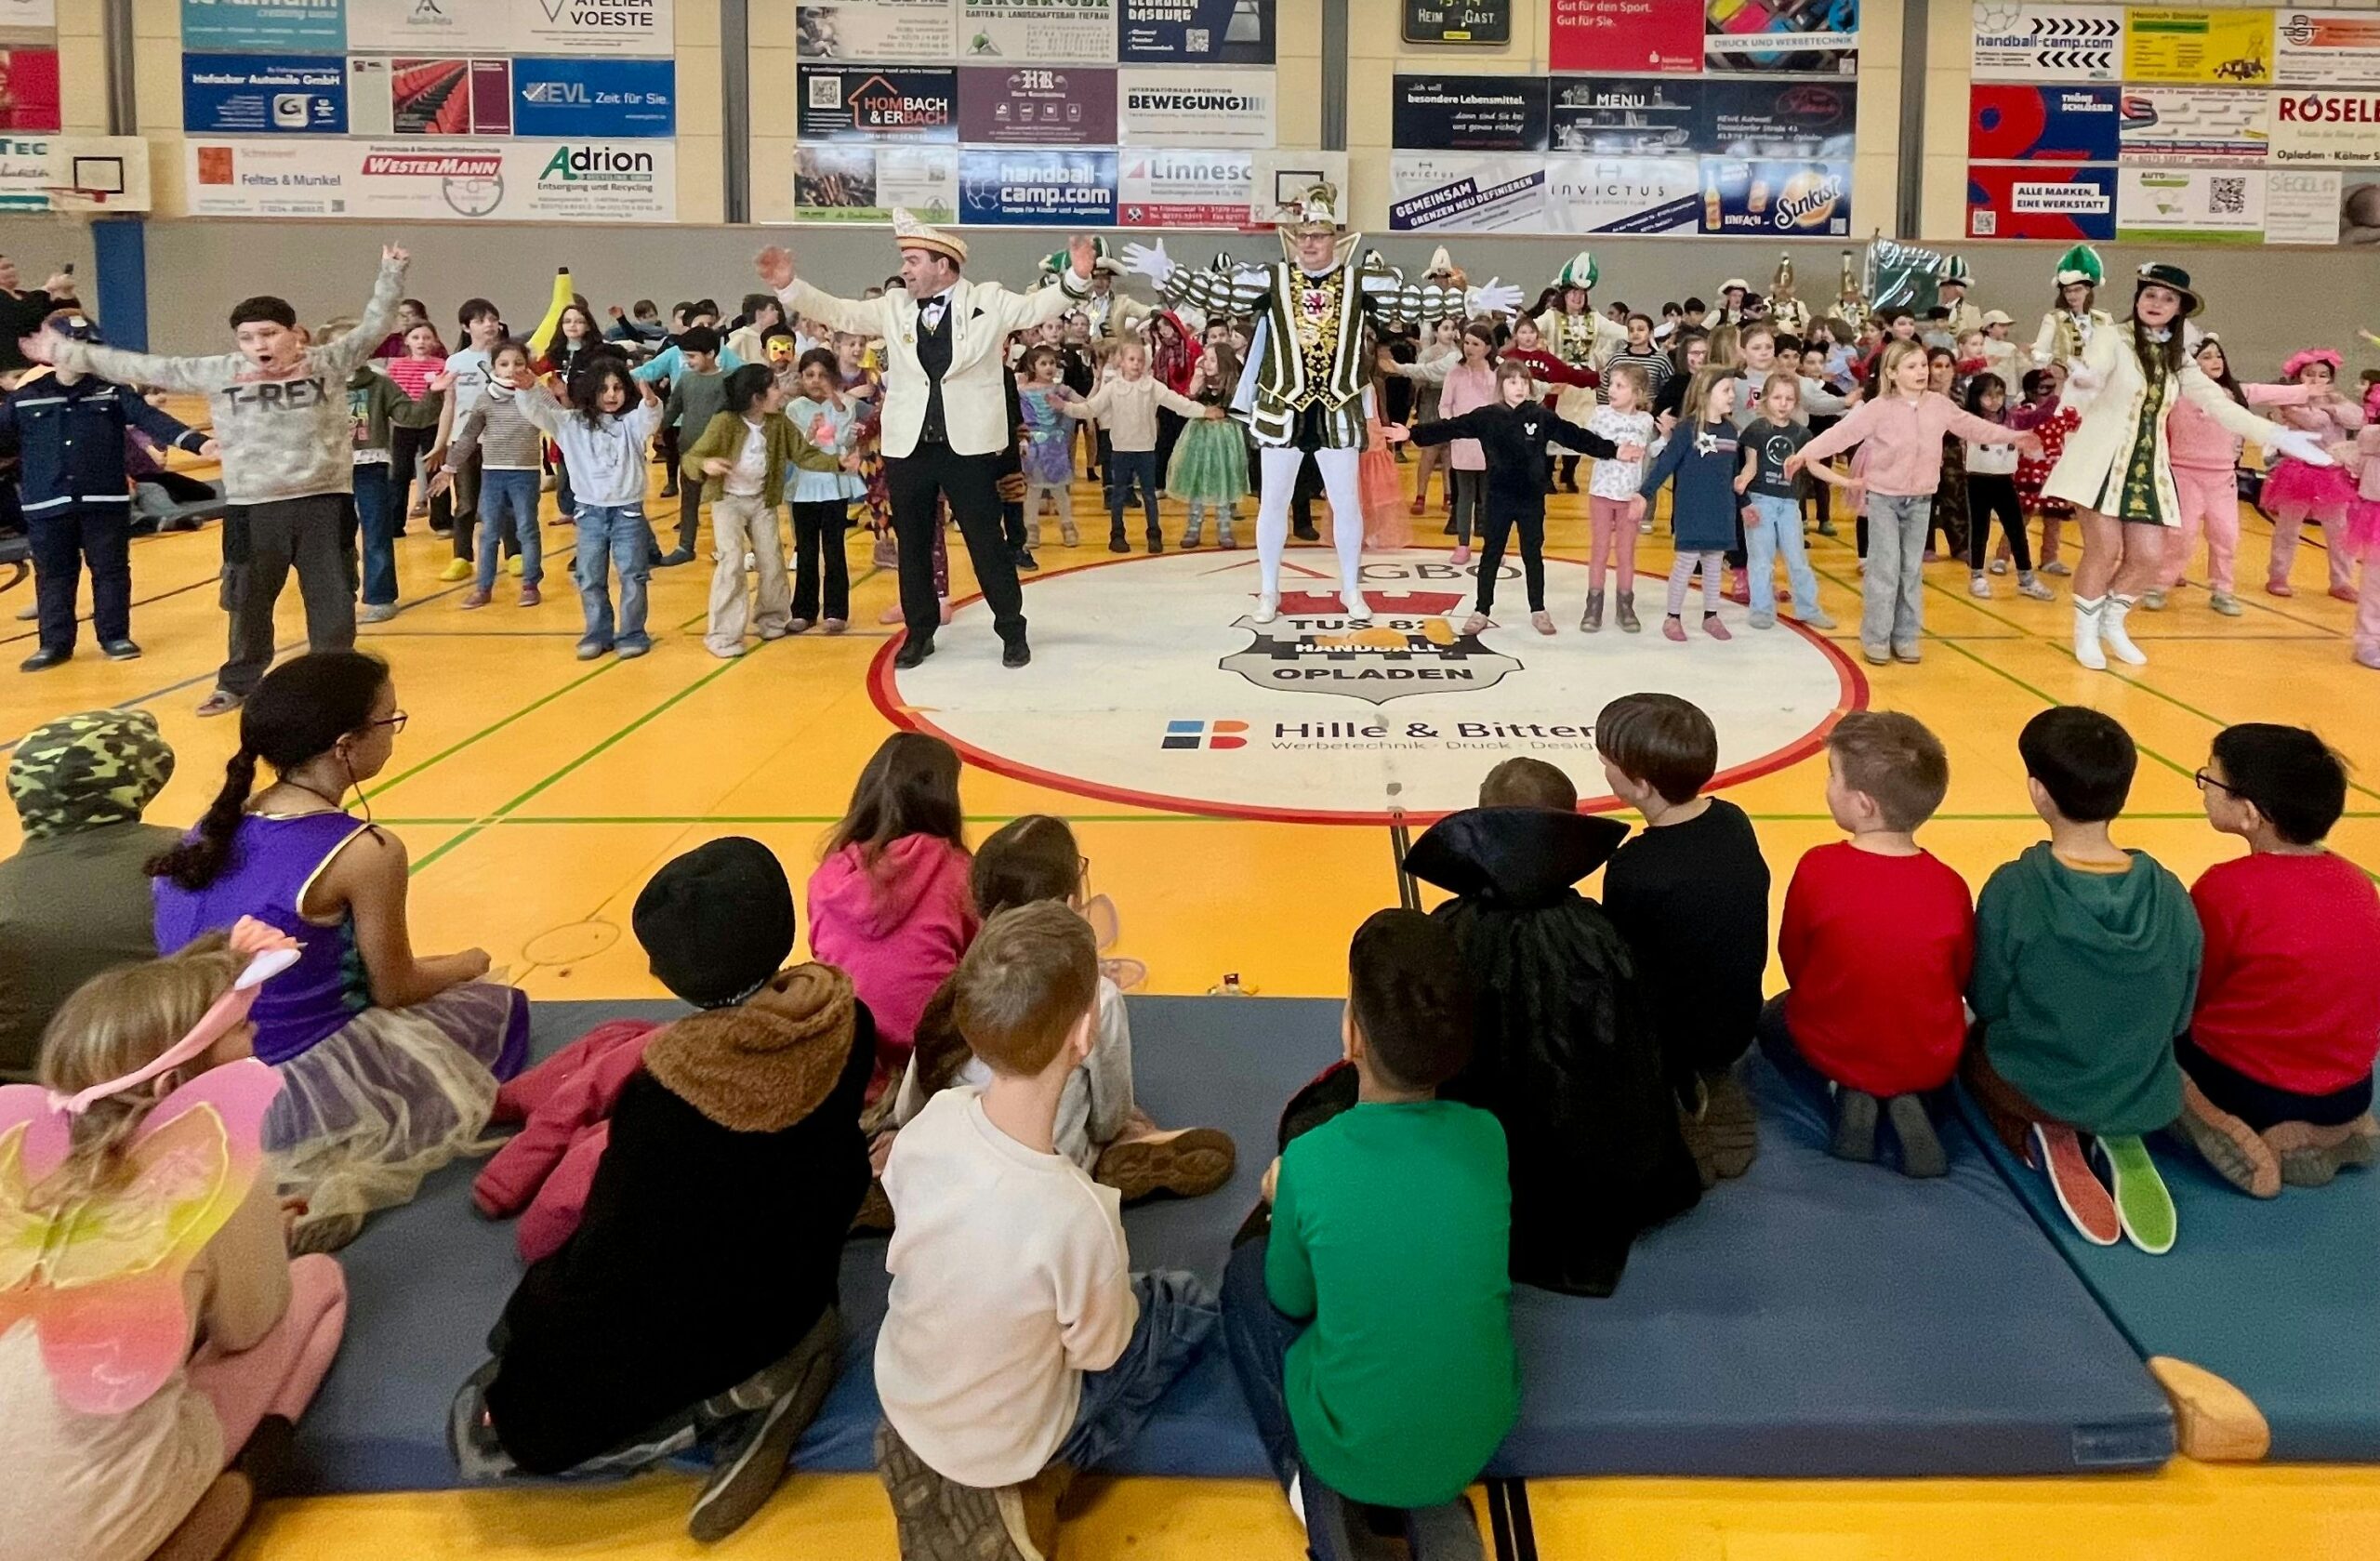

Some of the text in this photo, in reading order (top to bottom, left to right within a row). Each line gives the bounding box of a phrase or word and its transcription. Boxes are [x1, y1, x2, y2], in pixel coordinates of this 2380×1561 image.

[1556, 0, 1652, 14] Gut für den Sport.
[570, 11, 653, 26] VOESTE
[1556, 15, 1616, 27] Gut für Sie.
[1714, 36, 1854, 47] DRUCK UND WERBETECHNIK
[1976, 34, 2113, 50] handball-camp.com
[302, 74, 340, 85] GmbH
[548, 83, 592, 103] EVL
[595, 92, 621, 104] Zeit
[624, 92, 643, 104] für
[1408, 94, 1526, 105] besondere Lebensmittel.
[865, 97, 948, 112] HOMBACH
[1596, 94, 1646, 107] MENU
[869, 111, 948, 125] & ERBACH
[2277, 150, 2325, 161] Opladen
[538, 146, 654, 181] Adrion
[1001, 163, 1102, 184] handball-
[242, 174, 341, 187] Feltes & Munkel
[537, 182, 654, 193] Entsorgung und Recycling
[2017, 187, 2043, 196] ALLE
[1000, 187, 1111, 207] camp.com
[1395, 181, 1473, 218] GEMEINSAM
[1409, 205, 1455, 227] GRENZEN
[1455, 196, 1476, 212] NEU
[1476, 176, 1534, 205] DEFINIEREN
[1775, 175, 1842, 230] Sunkist
[2016, 200, 2106, 208] EINE WERKSTATT
[1724, 214, 1762, 227] EINFACH
[221, 377, 329, 416] T-REX
[1288, 619, 1373, 629] TUS
[1272, 668, 1474, 680] OPLADEN
[1275, 722, 1388, 737] Hille
[1405, 723, 1440, 738] &
[1273, 741, 1597, 751] Werbetechnik Druck Desig
